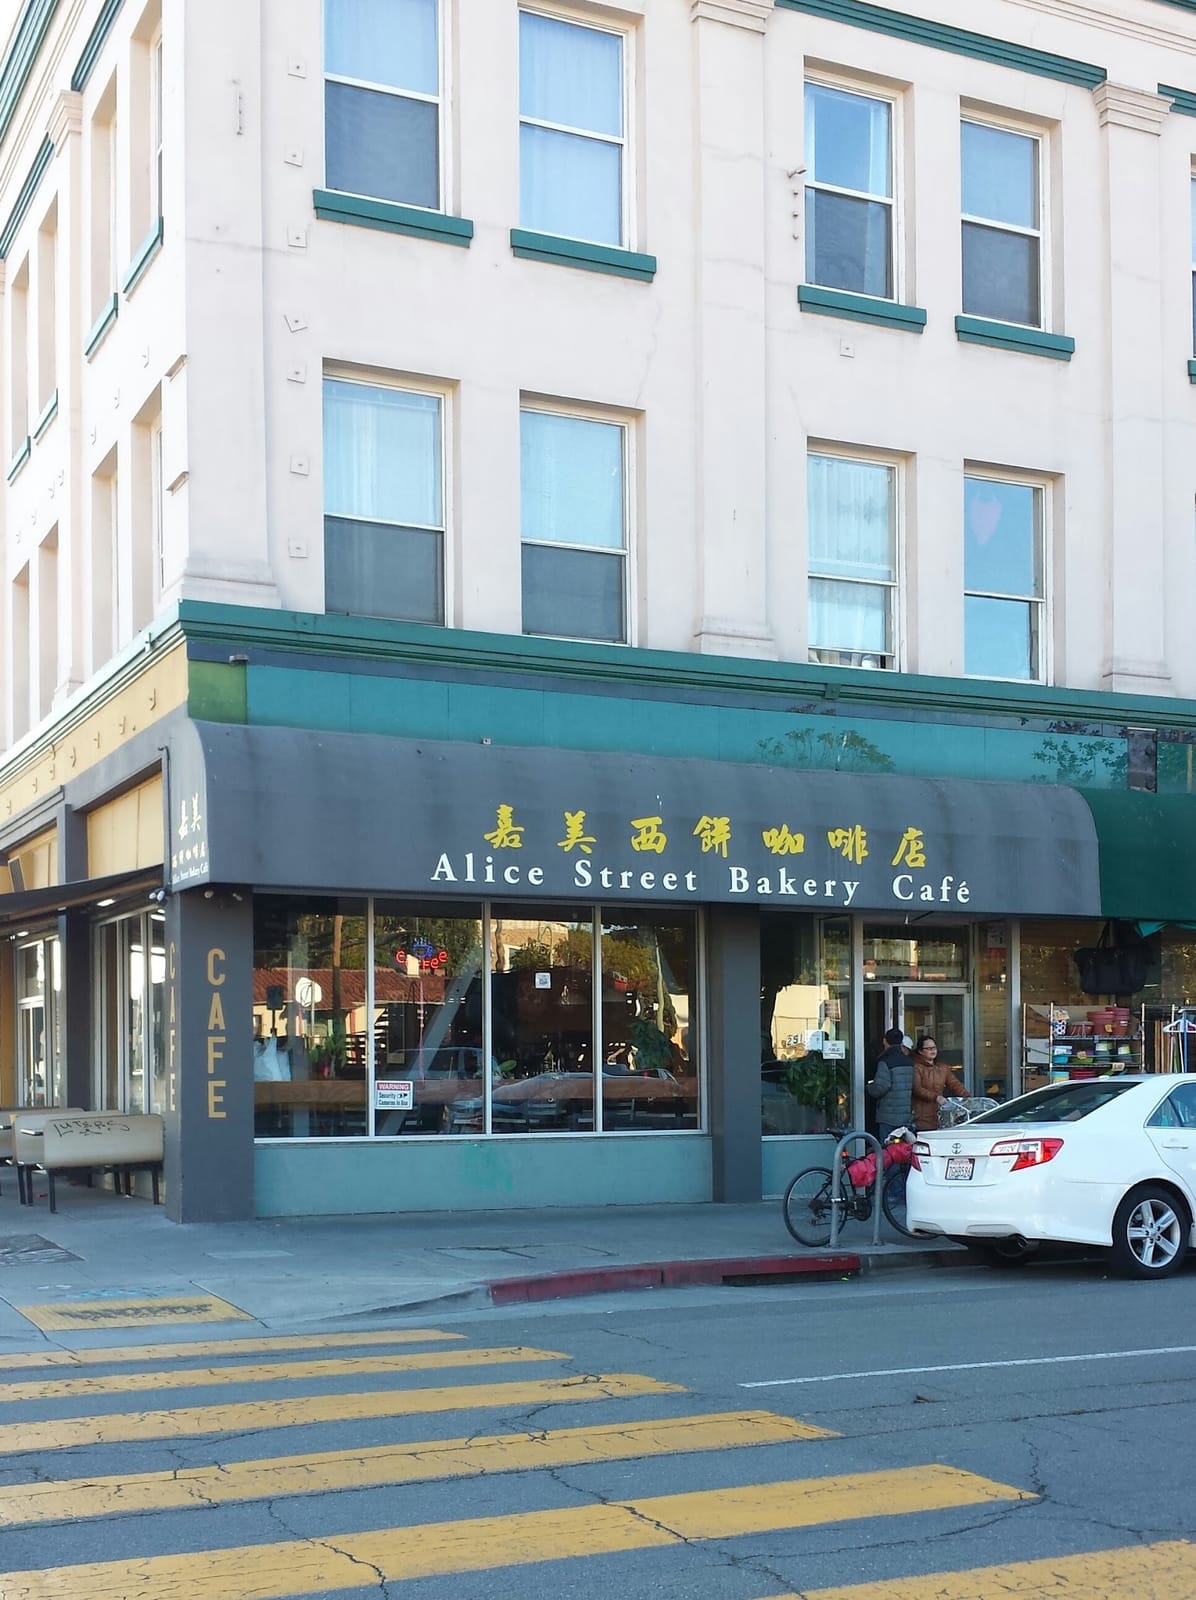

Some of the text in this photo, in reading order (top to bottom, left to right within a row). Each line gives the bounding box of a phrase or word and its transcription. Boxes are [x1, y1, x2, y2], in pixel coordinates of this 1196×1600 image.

[430, 853, 971, 906] Alice Street Bakery Café
[207, 947, 227, 1118] CAFE
